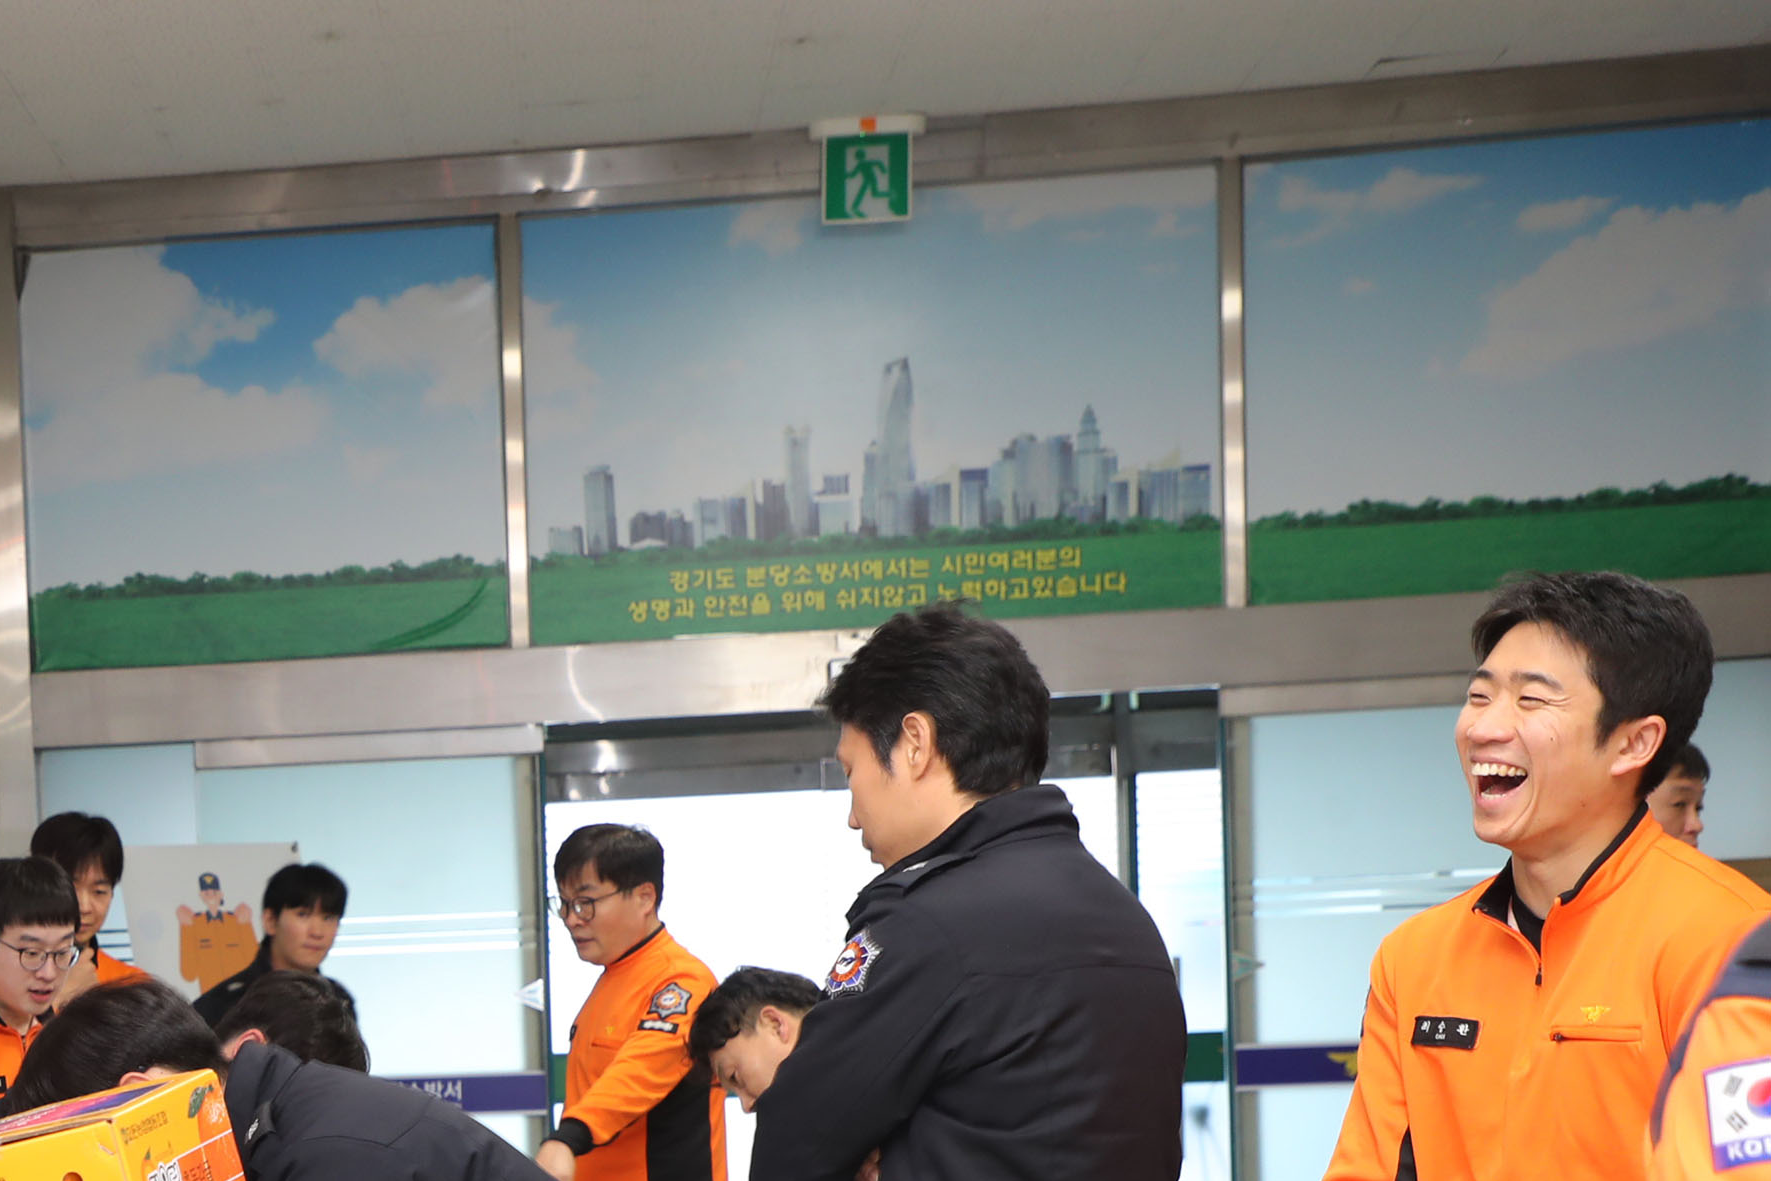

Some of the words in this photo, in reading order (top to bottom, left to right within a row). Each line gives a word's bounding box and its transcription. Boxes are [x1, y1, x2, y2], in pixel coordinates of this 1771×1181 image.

[669, 568, 735, 593] 경기도
[745, 557, 930, 589] 분당소방서에서는
[941, 546, 1082, 576] 시민여러분의
[628, 597, 695, 624] 생명과
[704, 591, 771, 618] 안전을
[781, 588, 827, 614] 위해
[836, 583, 926, 610] 쉬지않고
